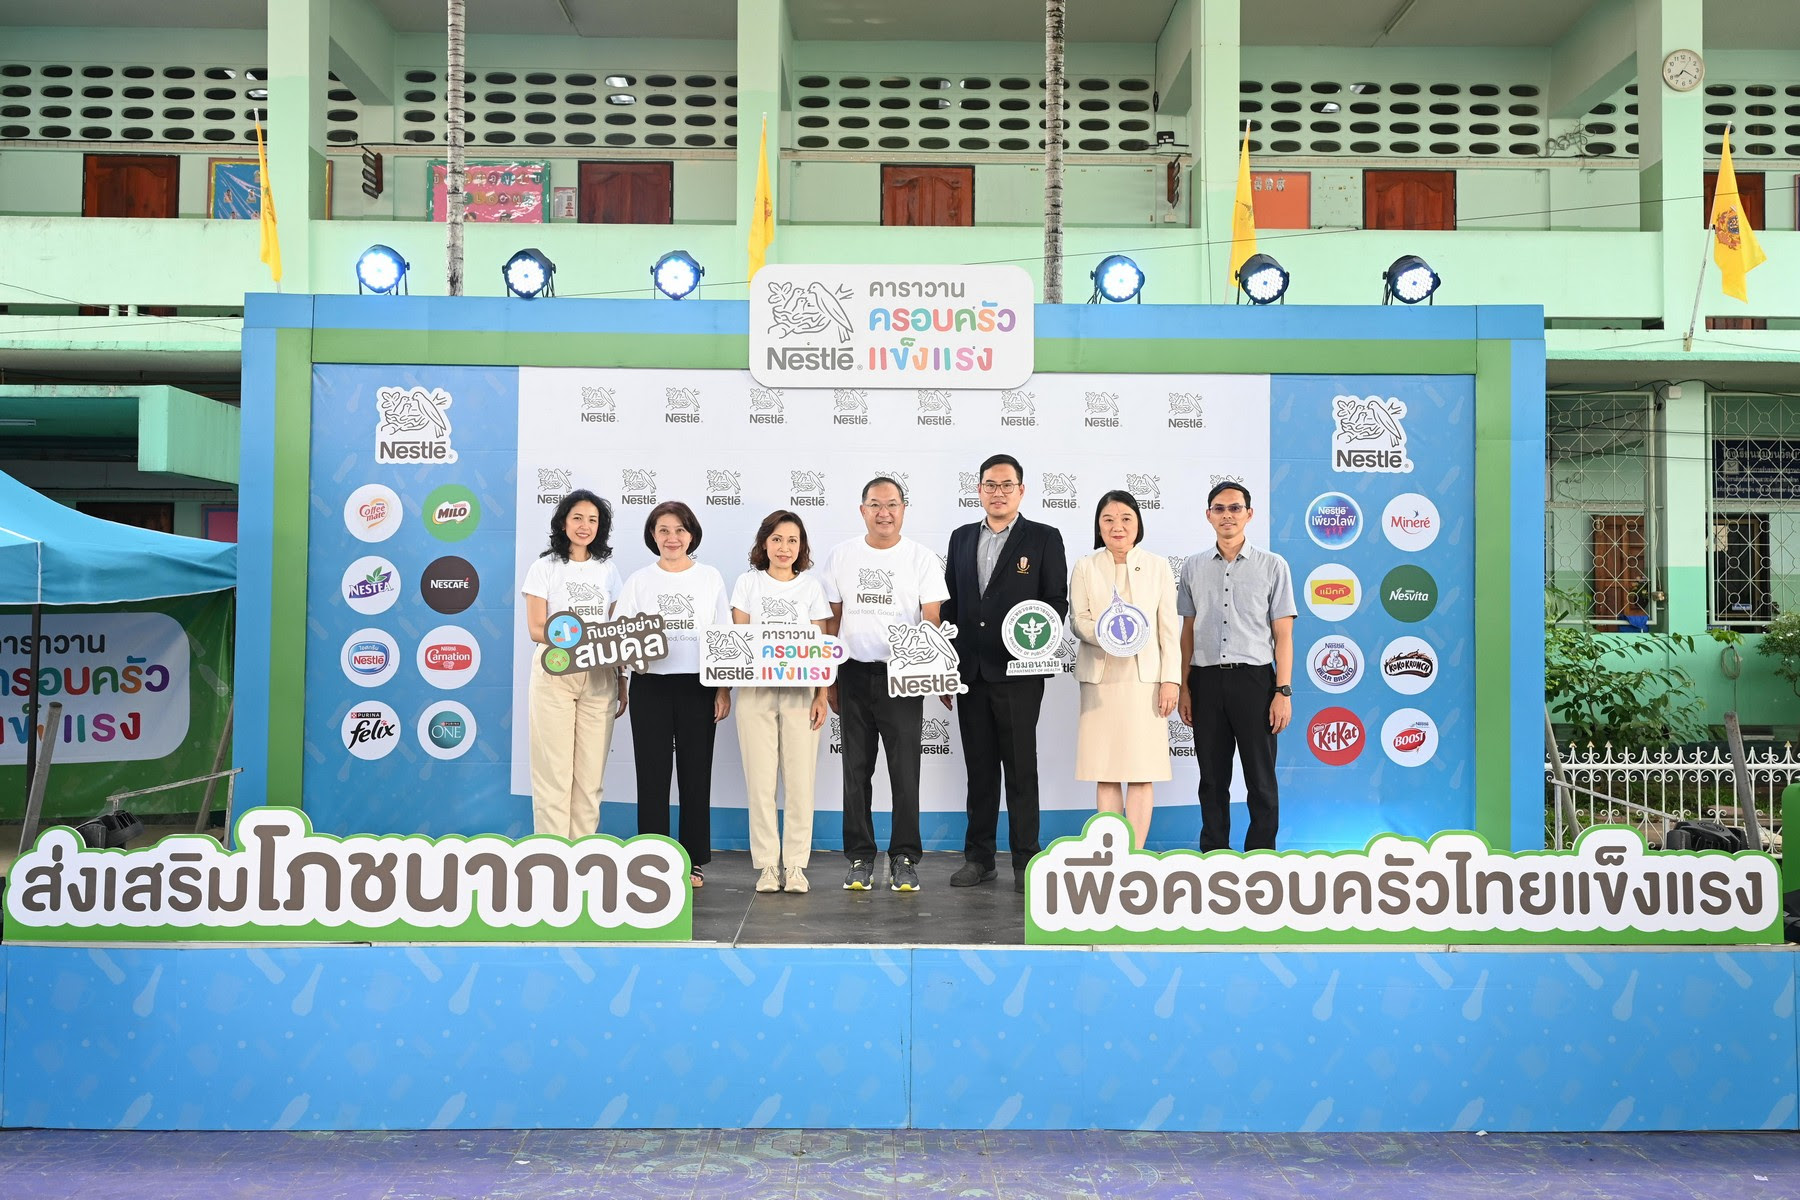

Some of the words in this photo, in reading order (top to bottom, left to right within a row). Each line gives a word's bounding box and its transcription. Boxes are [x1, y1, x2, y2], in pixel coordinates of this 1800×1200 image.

[869, 281, 965, 298] คาราวาน
[869, 300, 1016, 332] ครอบครัว
[767, 346, 854, 371] Nestlé
[869, 337, 993, 371] แข็งแรง
[581, 412, 616, 424] Nestlé
[665, 413, 700, 425] Nestlé
[749, 413, 784, 425] Nestlé
[833, 414, 868, 426] Nestlé
[917, 415, 952, 427] Nestlé
[1001, 416, 1036, 428] Nestlé
[1084, 416, 1119, 428] Nestlé
[1168, 417, 1203, 429] Nestlé
[380, 441, 446, 460] Nestlé
[1336, 449, 1402, 468] Nestlé
[621, 495, 657, 505] Nestlé
[706, 496, 741, 506] Nestlé
[790, 496, 825, 507] Nestlé
[1042, 498, 1077, 509] Nestlé
[1136, 500, 1161, 510] estlé
[437, 507, 468, 519] MILO
[1391, 515, 1431, 530] Mineré
[349, 581, 392, 597] NESTEA
[430, 577, 469, 589] NESCAFÉ
[856, 593, 893, 605] Nestlé
[1389, 587, 1429, 601] Nesvita
[587, 616, 660, 640] กินอยู่อย่าง
[663, 619, 695, 630] estlé
[762, 630, 815, 640] คาราวาน
[0, 634, 105, 655] าราวาน
[575, 633, 665, 670] สมดุล
[762, 640, 844, 659] ครอบครัว
[353, 655, 384, 665] Nestlé
[427, 648, 470, 664] Carnation
[762, 661, 831, 680] แข็งแรง
[1009, 658, 1060, 669] กรมอนามัย
[705, 666, 754, 680] Nestlé
[1316, 667, 1332, 682] BEAR
[1333, 667, 1354, 683] BRAND
[890, 673, 959, 695] Nestlé
[348, 720, 395, 750] felix
[431, 725, 462, 739] ONE
[1319, 722, 1357, 751] KitKat
[1395, 732, 1425, 747] BOOST
[1169, 746, 1197, 757] Nestl
[21, 825, 671, 914] ส่งเสริมโภชนาการ
[1046, 832, 1762, 916] เพื่อครอบครัวไทยแข็งแรง
